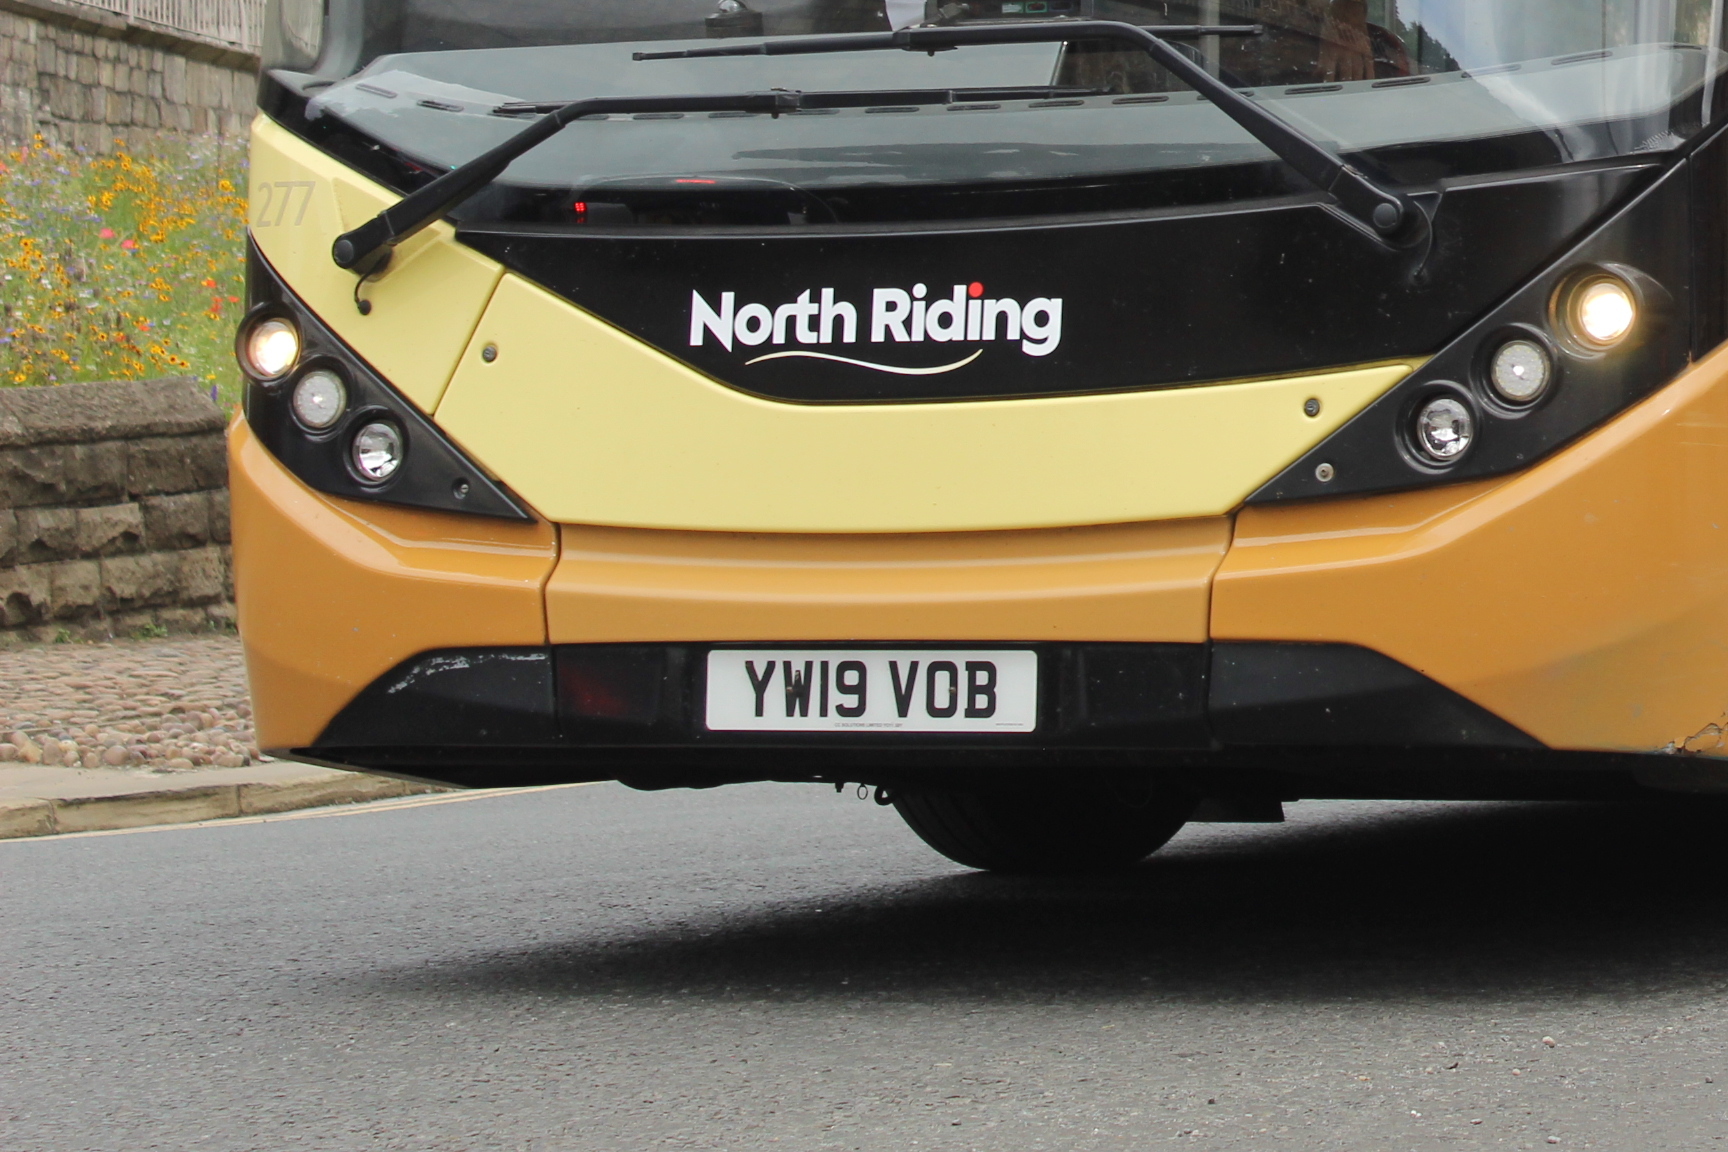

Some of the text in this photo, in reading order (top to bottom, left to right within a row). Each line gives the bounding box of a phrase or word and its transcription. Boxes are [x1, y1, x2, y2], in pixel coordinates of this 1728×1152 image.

[256, 180, 317, 228] 277
[689, 281, 1062, 356] North Riding
[745, 660, 997, 718] YW19 VOB
